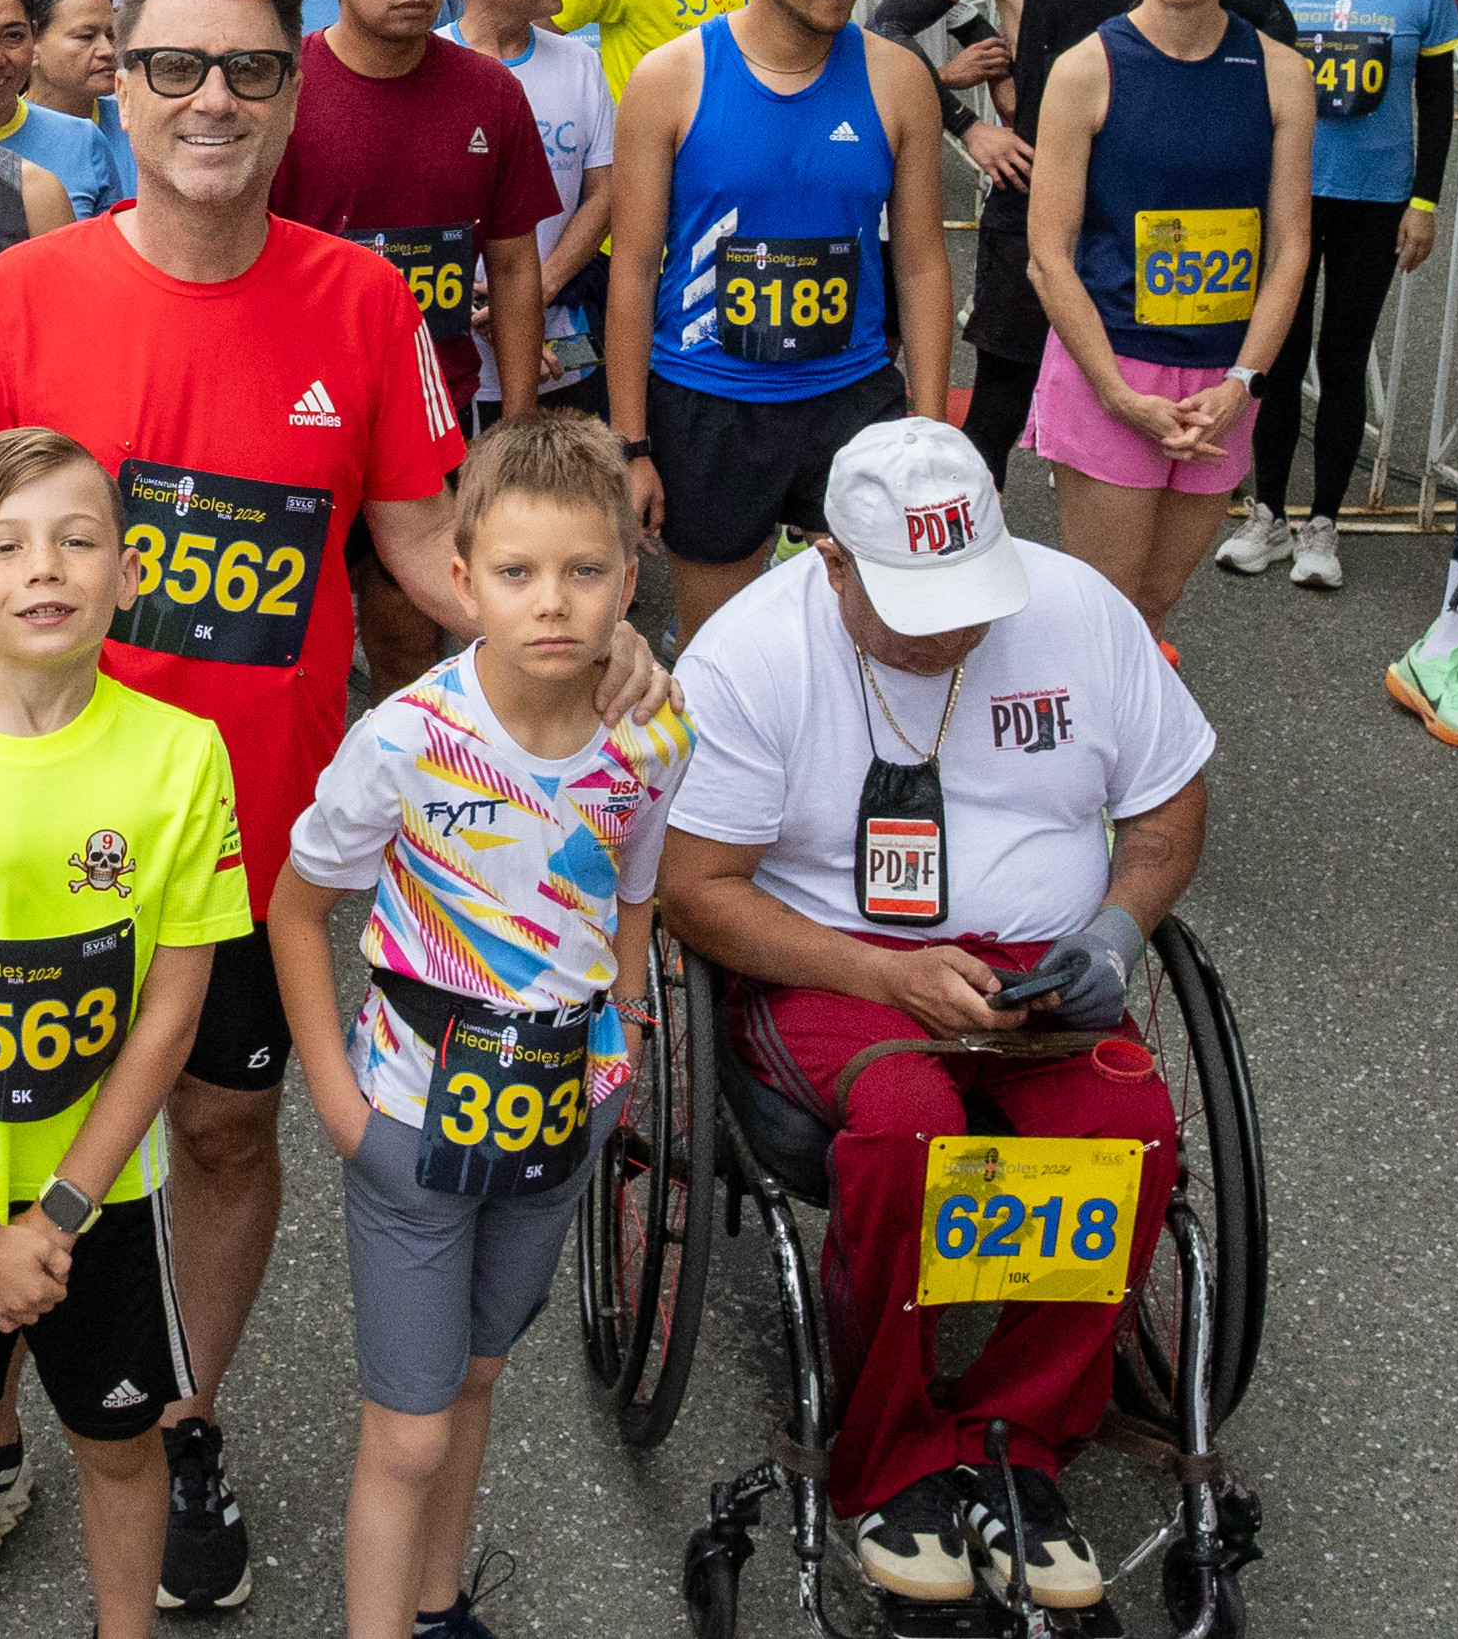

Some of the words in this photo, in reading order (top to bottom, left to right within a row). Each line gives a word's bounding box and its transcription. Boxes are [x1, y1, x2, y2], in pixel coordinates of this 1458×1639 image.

[726, 251, 758, 264] Heart
[1145, 248, 1253, 296] 6522
[725, 276, 848, 327] 3183
[783, 339, 797, 349] 5K
[288, 412, 342, 428] rowdies
[139, 477, 178, 490] LUMENTUM
[131, 483, 178, 505] Heart
[190, 493, 234, 515] Soles
[234, 508, 267, 523] 2026
[124, 524, 305, 617] 3562
[194, 625, 214, 641] 5K
[609, 780, 641, 796] USA
[102, 834, 113, 850] 9
[7, 977, 24, 985] RUN
[26, 966, 63, 983] 2026
[455, 1029, 501, 1055] Heart
[514, 1045, 561, 1065] Soles
[12, 1089, 33, 1105] 5K
[440, 1072, 587, 1153] 393
[525, 1164, 543, 1179] 5K
[935, 1193, 1119, 1261] 6218
[1007, 1272, 1031, 1284] 10K
